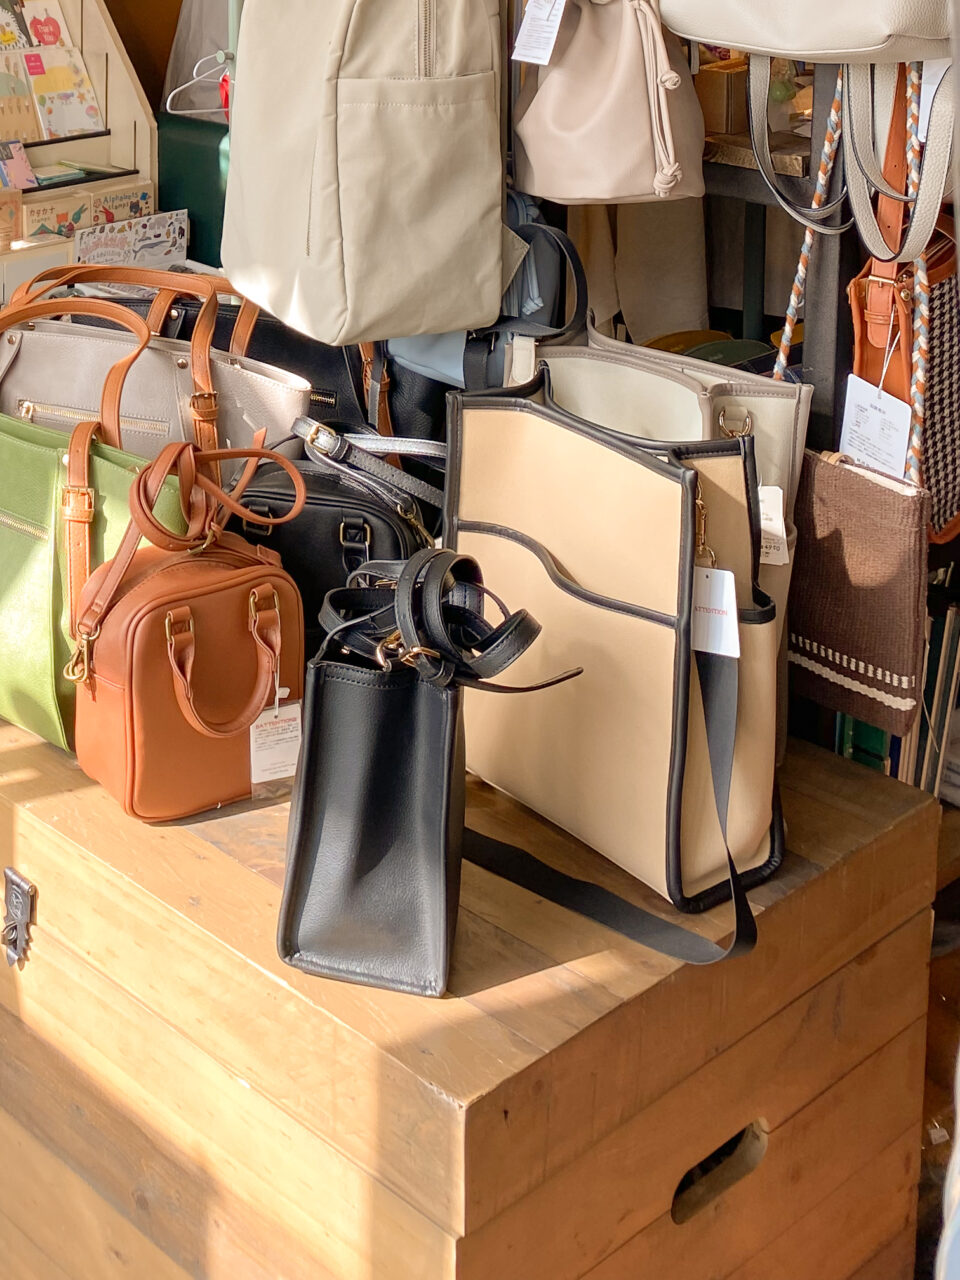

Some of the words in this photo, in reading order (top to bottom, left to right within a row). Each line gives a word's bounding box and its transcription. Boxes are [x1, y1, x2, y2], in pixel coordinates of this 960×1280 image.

[103, 192, 139, 205] Alphabets
[29, 206, 55, 217] カタカナ
